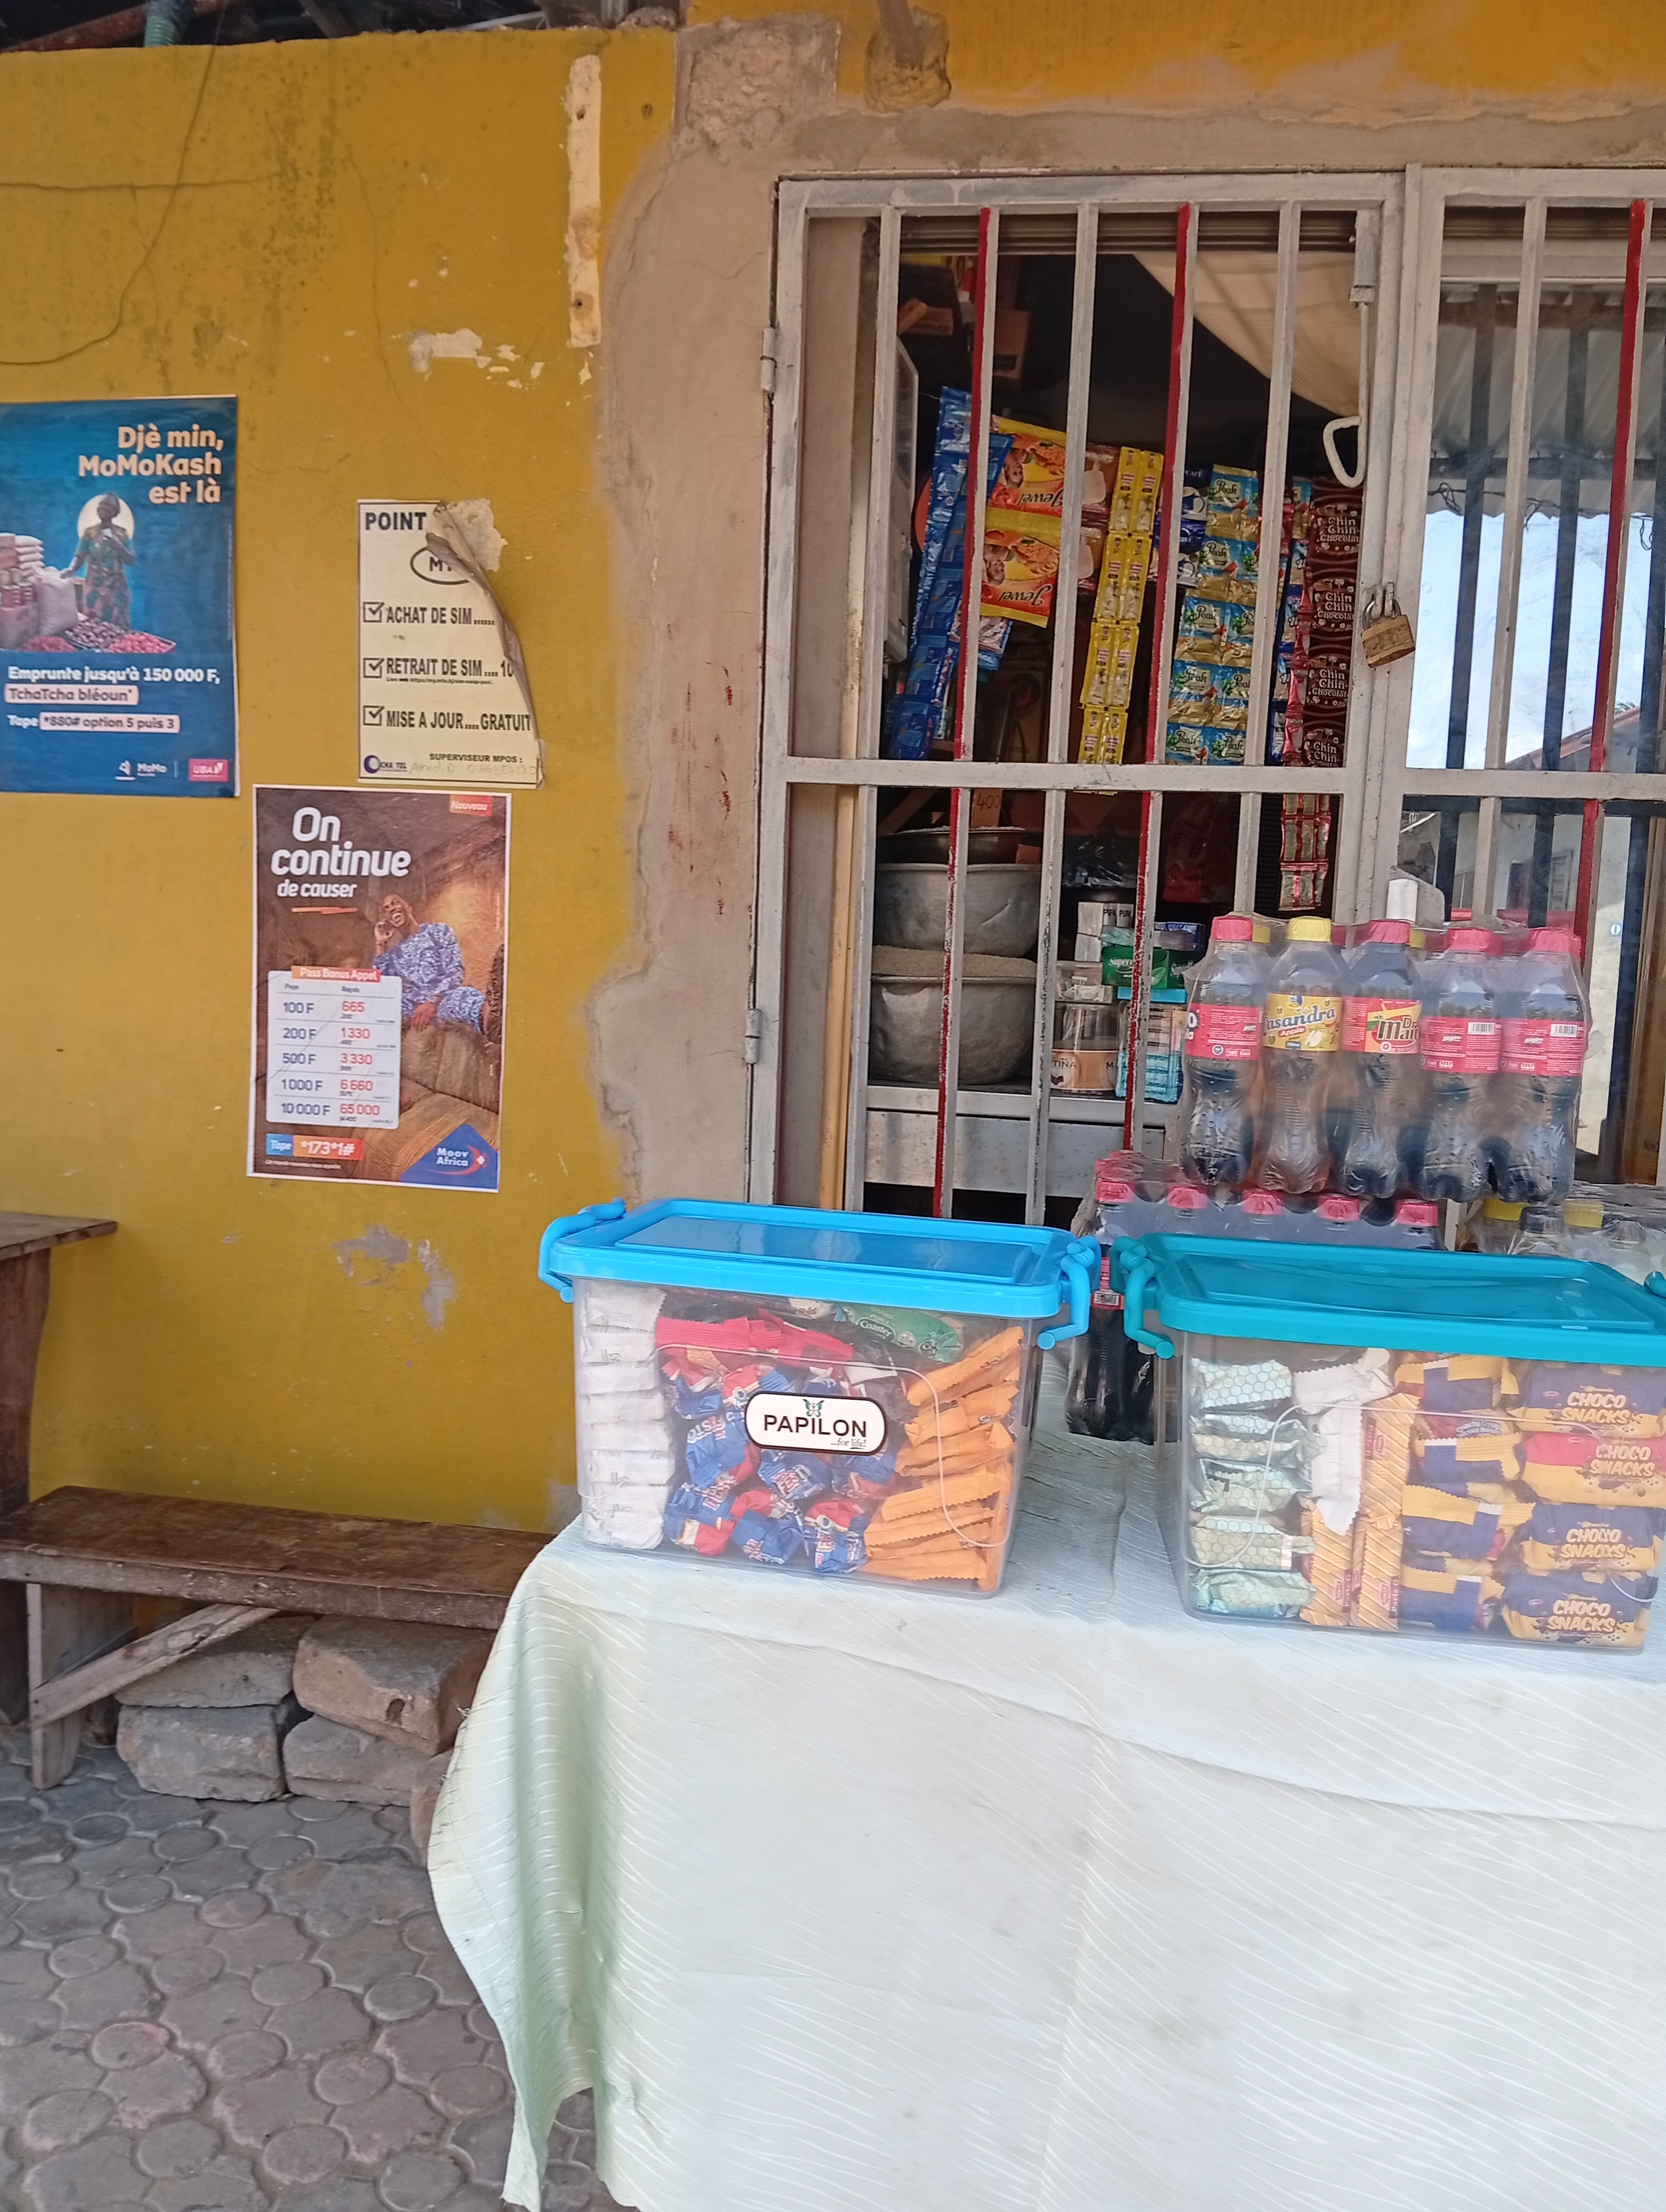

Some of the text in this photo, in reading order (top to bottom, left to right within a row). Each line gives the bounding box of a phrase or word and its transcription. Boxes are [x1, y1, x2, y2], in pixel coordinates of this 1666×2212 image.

[118, 423, 223, 453] Djè min,
[79, 452, 222, 477] MoMoKash
[149, 477, 221, 504] est là
[366, 512, 427, 530] POINT
[1328, 517, 1356, 525] Chin
[998, 584, 1053, 606] Jewel
[1325, 592, 1352, 602] Chin
[386, 607, 427, 623] ACHAT
[432, 607, 446, 624] DE
[387, 658, 438, 675] RETRAIT
[441, 659, 457, 676] DE
[1319, 669, 1345, 680] Chin
[8, 666, 82, 683] Emprunte
[84, 666, 140, 684] jusqu'à
[143, 668, 172, 681] 150
[174, 669, 204, 682] 000
[9, 687, 74, 701] TchaTcha
[7, 715, 39, 729] Tape
[83, 717, 124, 730] option
[126, 717, 134, 728] 5
[137, 718, 163, 731] puis
[167, 718, 174, 729] 3
[387, 711, 415, 728] MISE
[419, 712, 428, 728] A
[1313, 742, 1337, 753] Chin
[430, 753, 491, 763] SUPERVISEUR
[137, 762, 168, 774] MoMo
[193, 765, 214, 774] UBA
[451, 800, 489, 812] Nouveau
[977, 792, 1001, 810] 400
[292, 806, 341, 842] On
[271, 841, 412, 877] continue
[277, 879, 358, 898] de causer
[299, 968, 379, 982] Pass Bonus Appel
[282, 1002, 315, 1014] 100 F
[342, 1000, 366, 1013] 665
[283, 1027, 317, 1040] 200 F
[1280, 1027, 1305, 1037] Apple
[282, 1053, 316, 1065] 500 F
[315, 1079, 323, 1091] F
[323, 1104, 331, 1116] F
[271, 1139, 292, 1152] Tape
[437, 1147, 469, 1158] Moov
[436, 1156, 469, 1167] Africa
[860, 1320, 892, 1337] Coaster
[1567, 1392, 1626, 1409] CHOCO
[1561, 1407, 1631, 1424] SNACKS
[764, 1414, 867, 1437] PAPILON
[850, 1438, 867, 1449] life!
[1595, 1444, 1651, 1460] CHOCO
[1589, 1459, 1656, 1477] SNACKS
[1566, 1529, 1622, 1544] CHOCO
[1560, 1544, 1627, 1559] SNACKS
[1553, 1599, 1612, 1617] CHOCO
[1547, 1615, 1618, 1632] SNACKS
